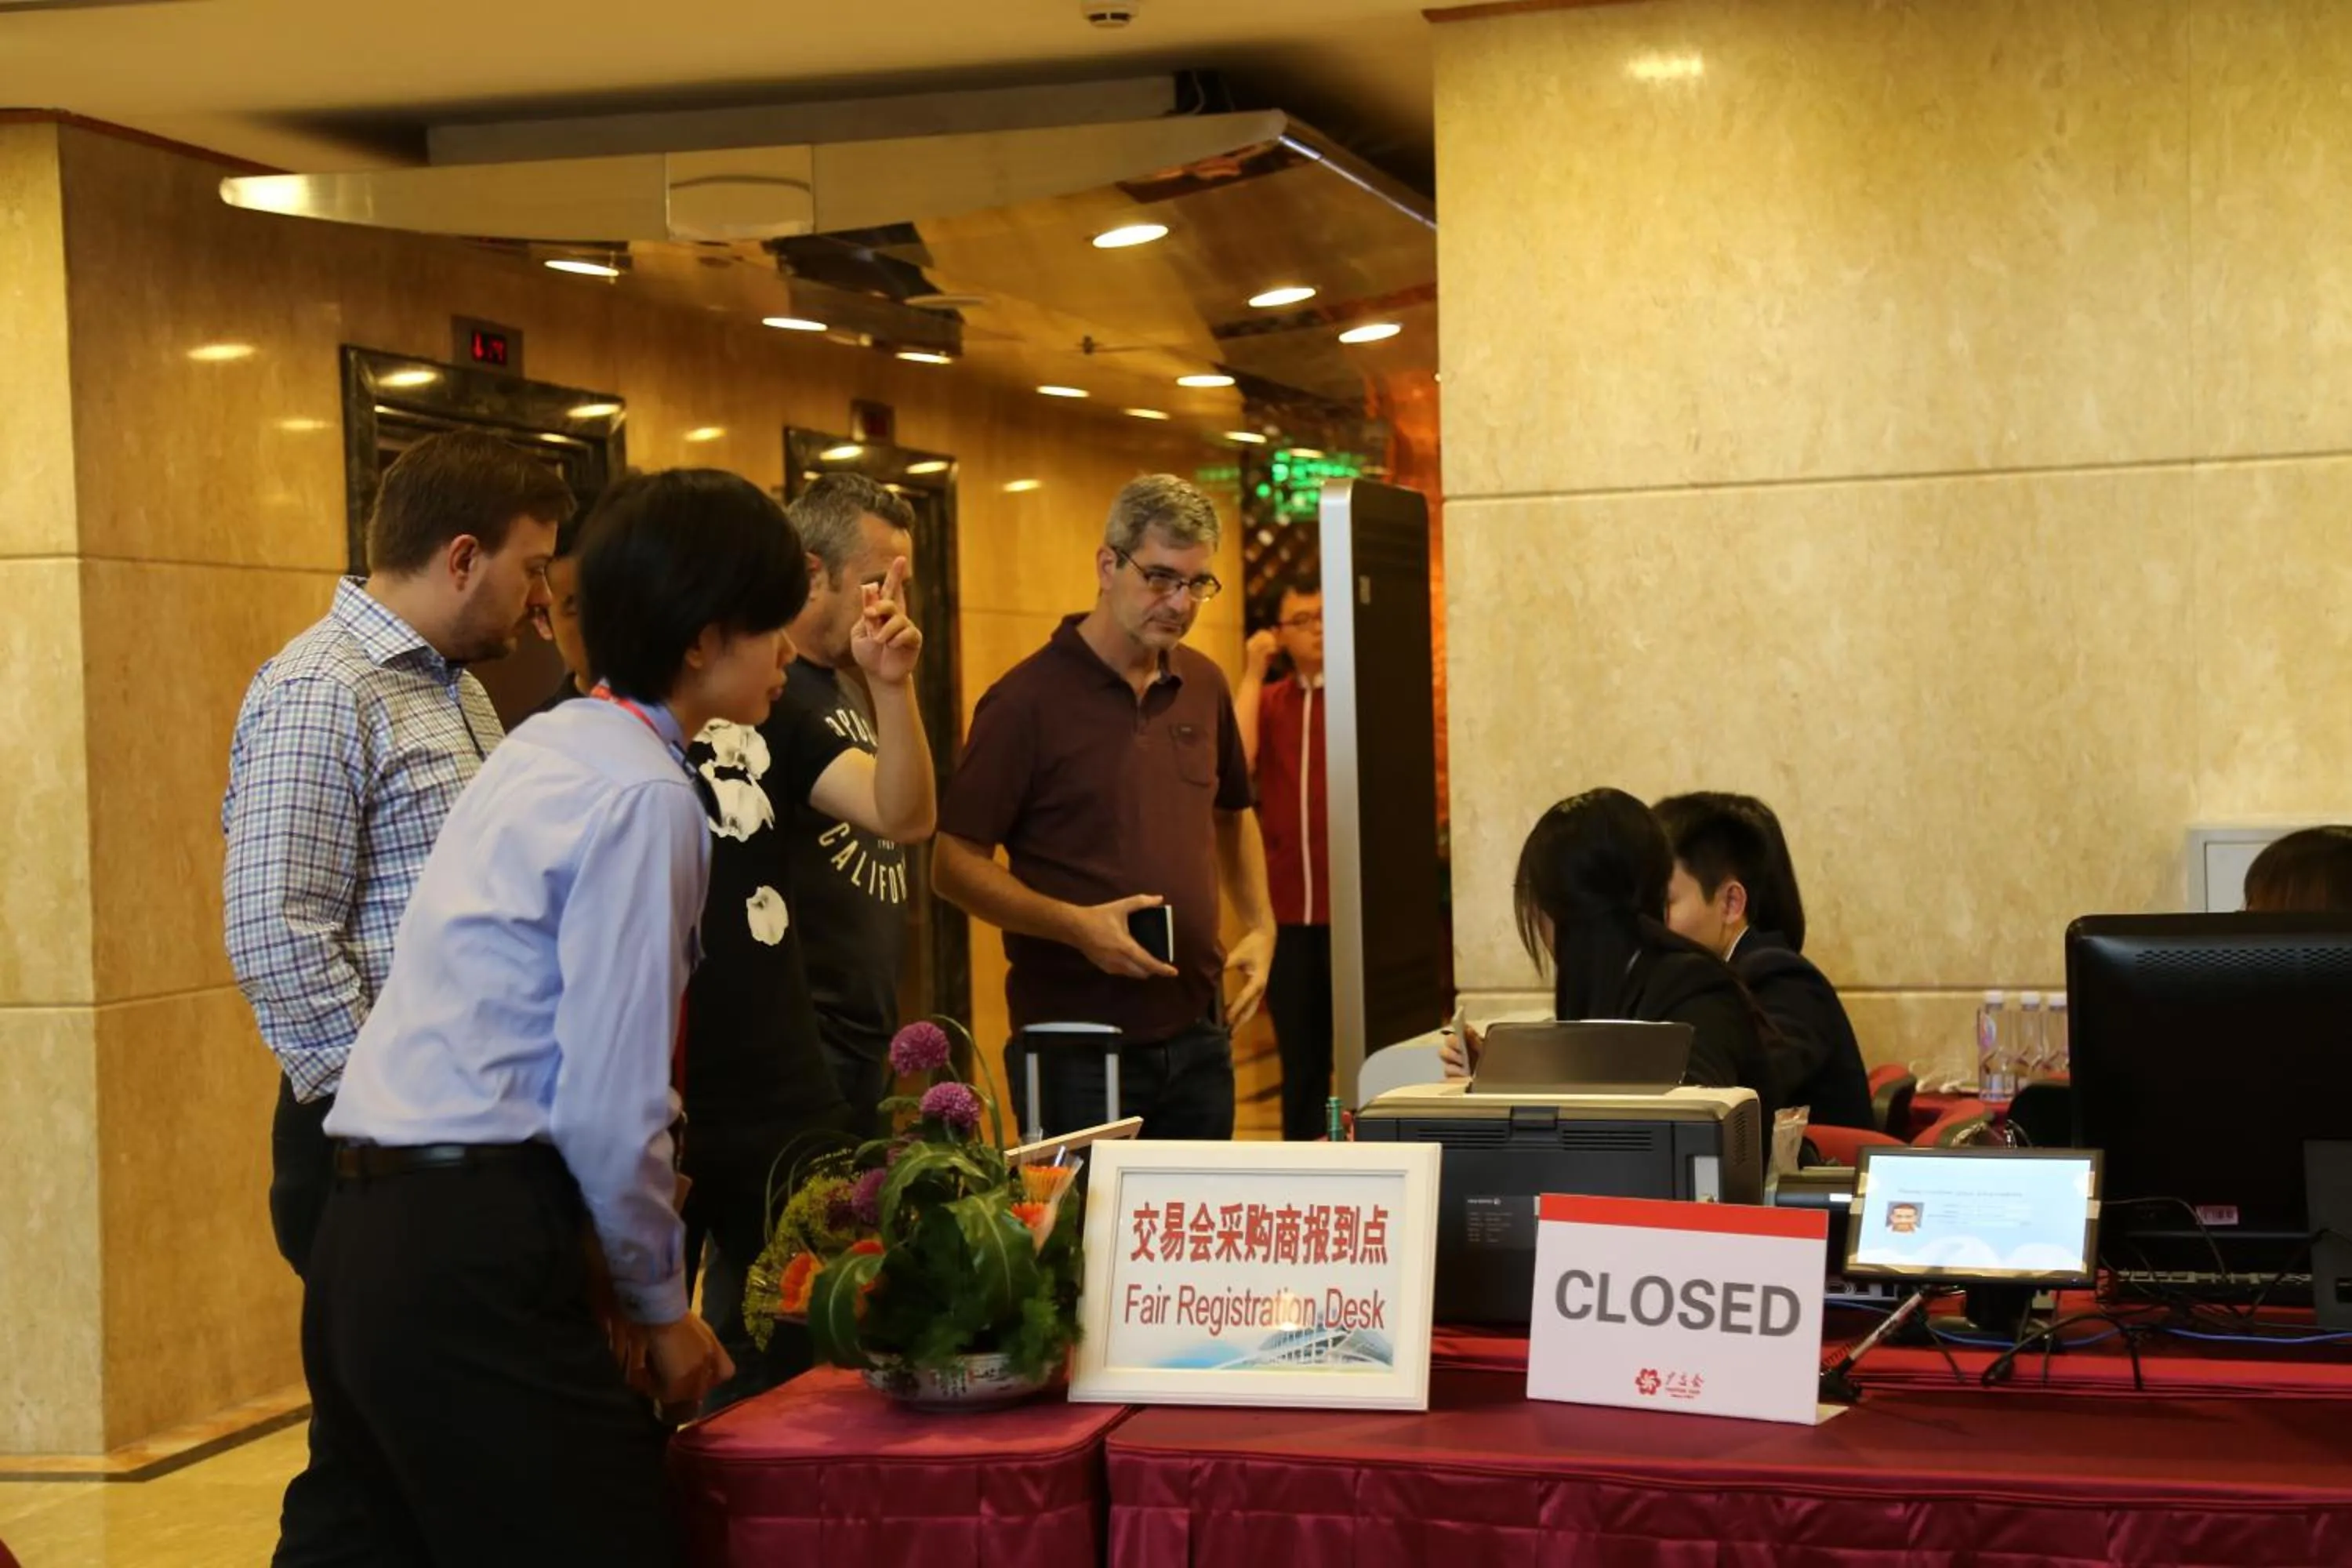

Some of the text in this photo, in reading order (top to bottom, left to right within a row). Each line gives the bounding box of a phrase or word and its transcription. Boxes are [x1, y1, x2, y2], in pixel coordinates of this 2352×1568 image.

[1130, 1201, 1389, 1265] 交易会采购商报到点
[1124, 1283, 1386, 1337] Fair Registration Desk
[1555, 1269, 1802, 1337] CLOSED
